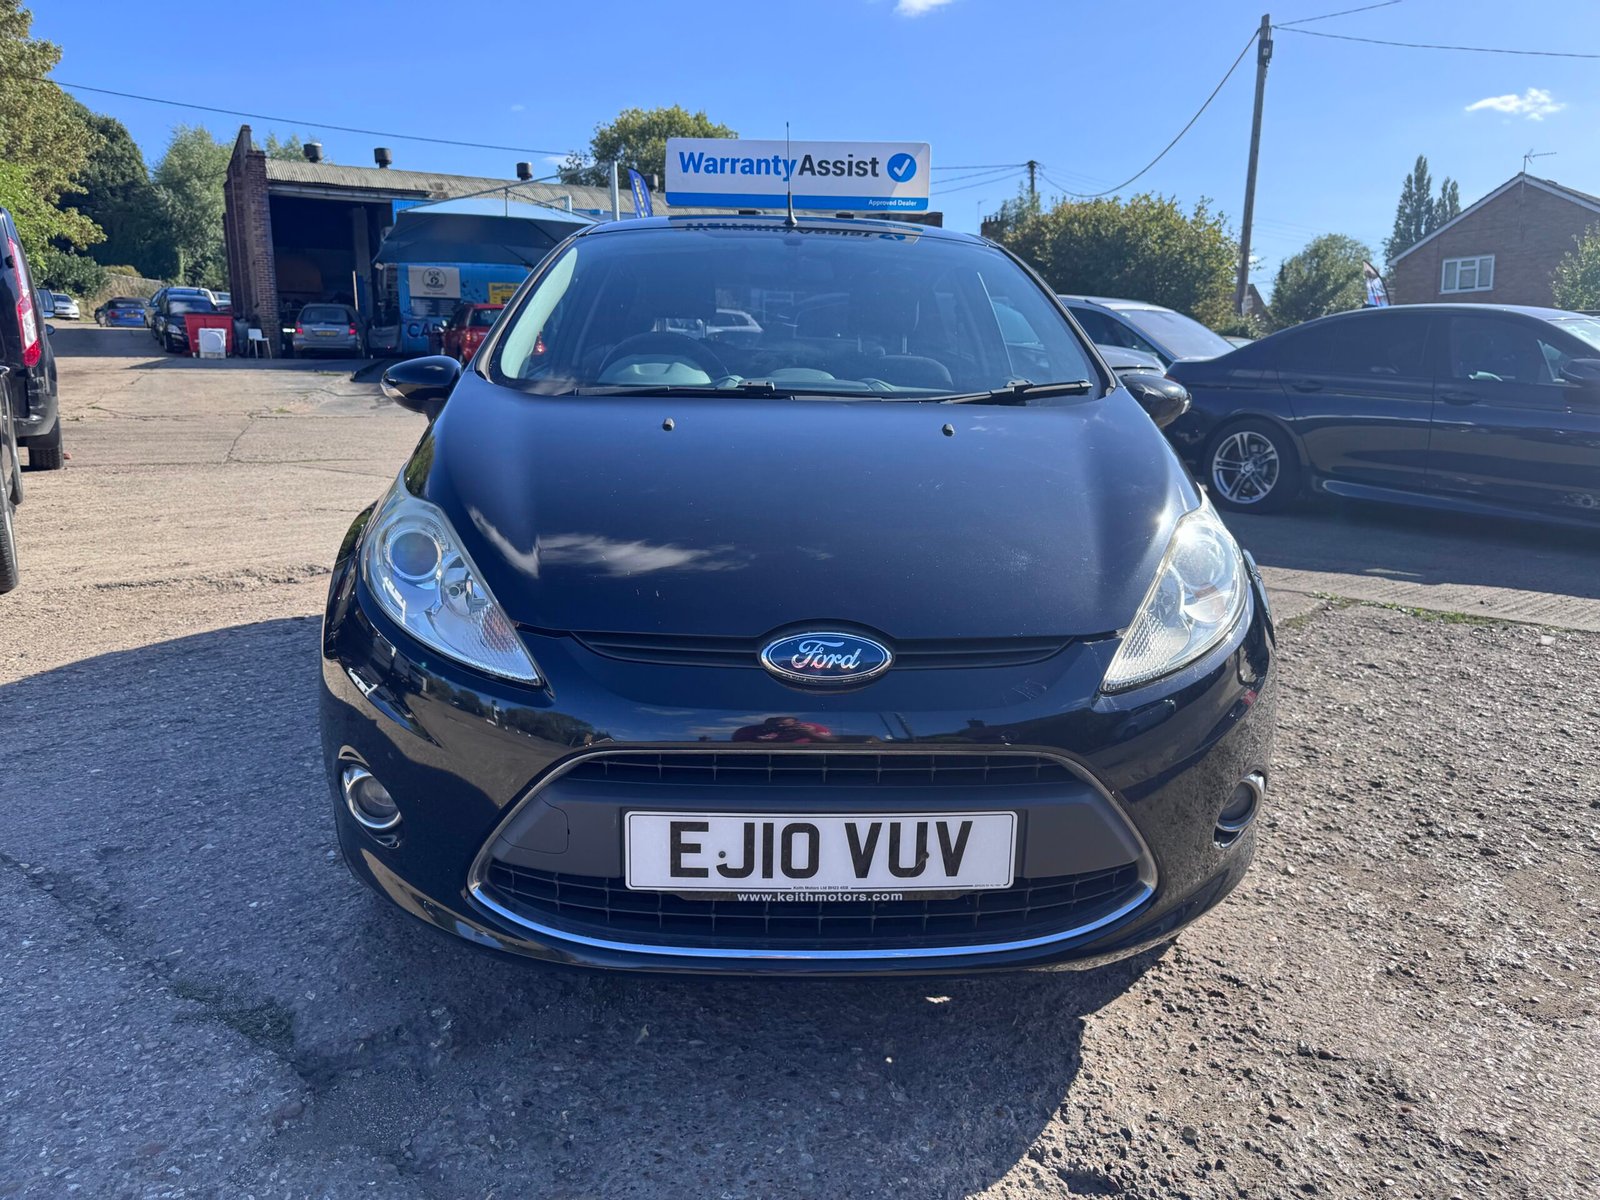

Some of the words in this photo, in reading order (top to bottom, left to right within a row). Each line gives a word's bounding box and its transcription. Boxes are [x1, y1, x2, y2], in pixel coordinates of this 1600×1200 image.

[868, 199, 897, 207] Approved
[897, 199, 917, 207] Dealer
[791, 639, 862, 669] Ford
[669, 820, 820, 879] EJ10
[844, 820, 973, 879] VUV
[737, 891, 903, 903] www.keithmotors.com
